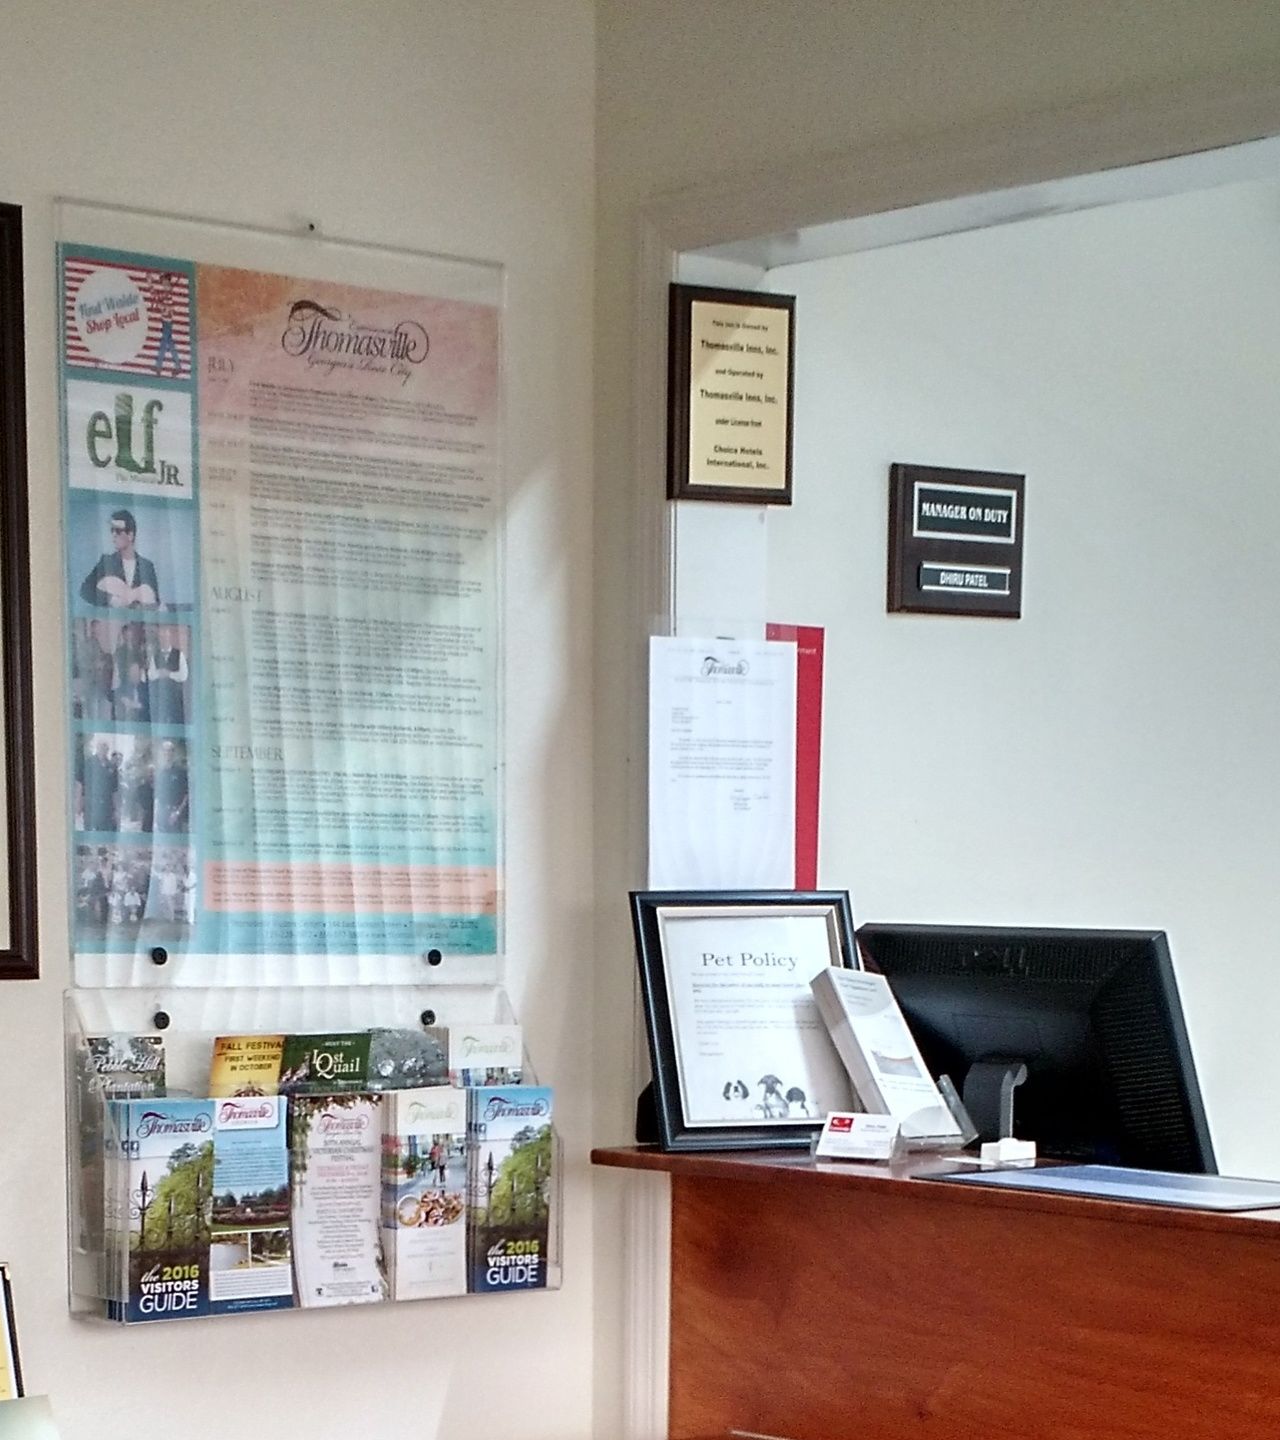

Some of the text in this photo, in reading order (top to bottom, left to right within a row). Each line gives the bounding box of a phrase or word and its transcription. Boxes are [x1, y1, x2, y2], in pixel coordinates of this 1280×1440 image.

[86, 319, 112, 334] Shop
[281, 299, 429, 363] Thomasville
[701, 340, 779, 356] Thomasville Inns, Inc.
[700, 389, 778, 404] Thomasville Inns, Inc.
[86, 393, 163, 474] elf
[713, 445, 763, 456] Choice Hotels
[921, 502, 1009, 524] MANAGER ON DUTY
[940, 571, 989, 587] DHIRU PATEL
[702, 952, 798, 972] Pet Policy
[221, 1041, 242, 1051] FALL
[85, 1052, 161, 1073] Pebble Hill
[225, 1052, 281, 1063] FIRST WEEKEND
[315, 1053, 360, 1079] Quail
[230, 1063, 272, 1072] IN OCTOBER
[89, 1075, 156, 1094] Plantation
[137, 1112, 212, 1138] Thomasville
[487, 1238, 540, 1256] the 2016
[487, 1254, 539, 1267] VISITORS
[140, 1263, 200, 1283] the 2016
[486, 1265, 539, 1285] GUIDE
[140, 1279, 200, 1295] VISITORS
[139, 1291, 199, 1313] GUIDE
